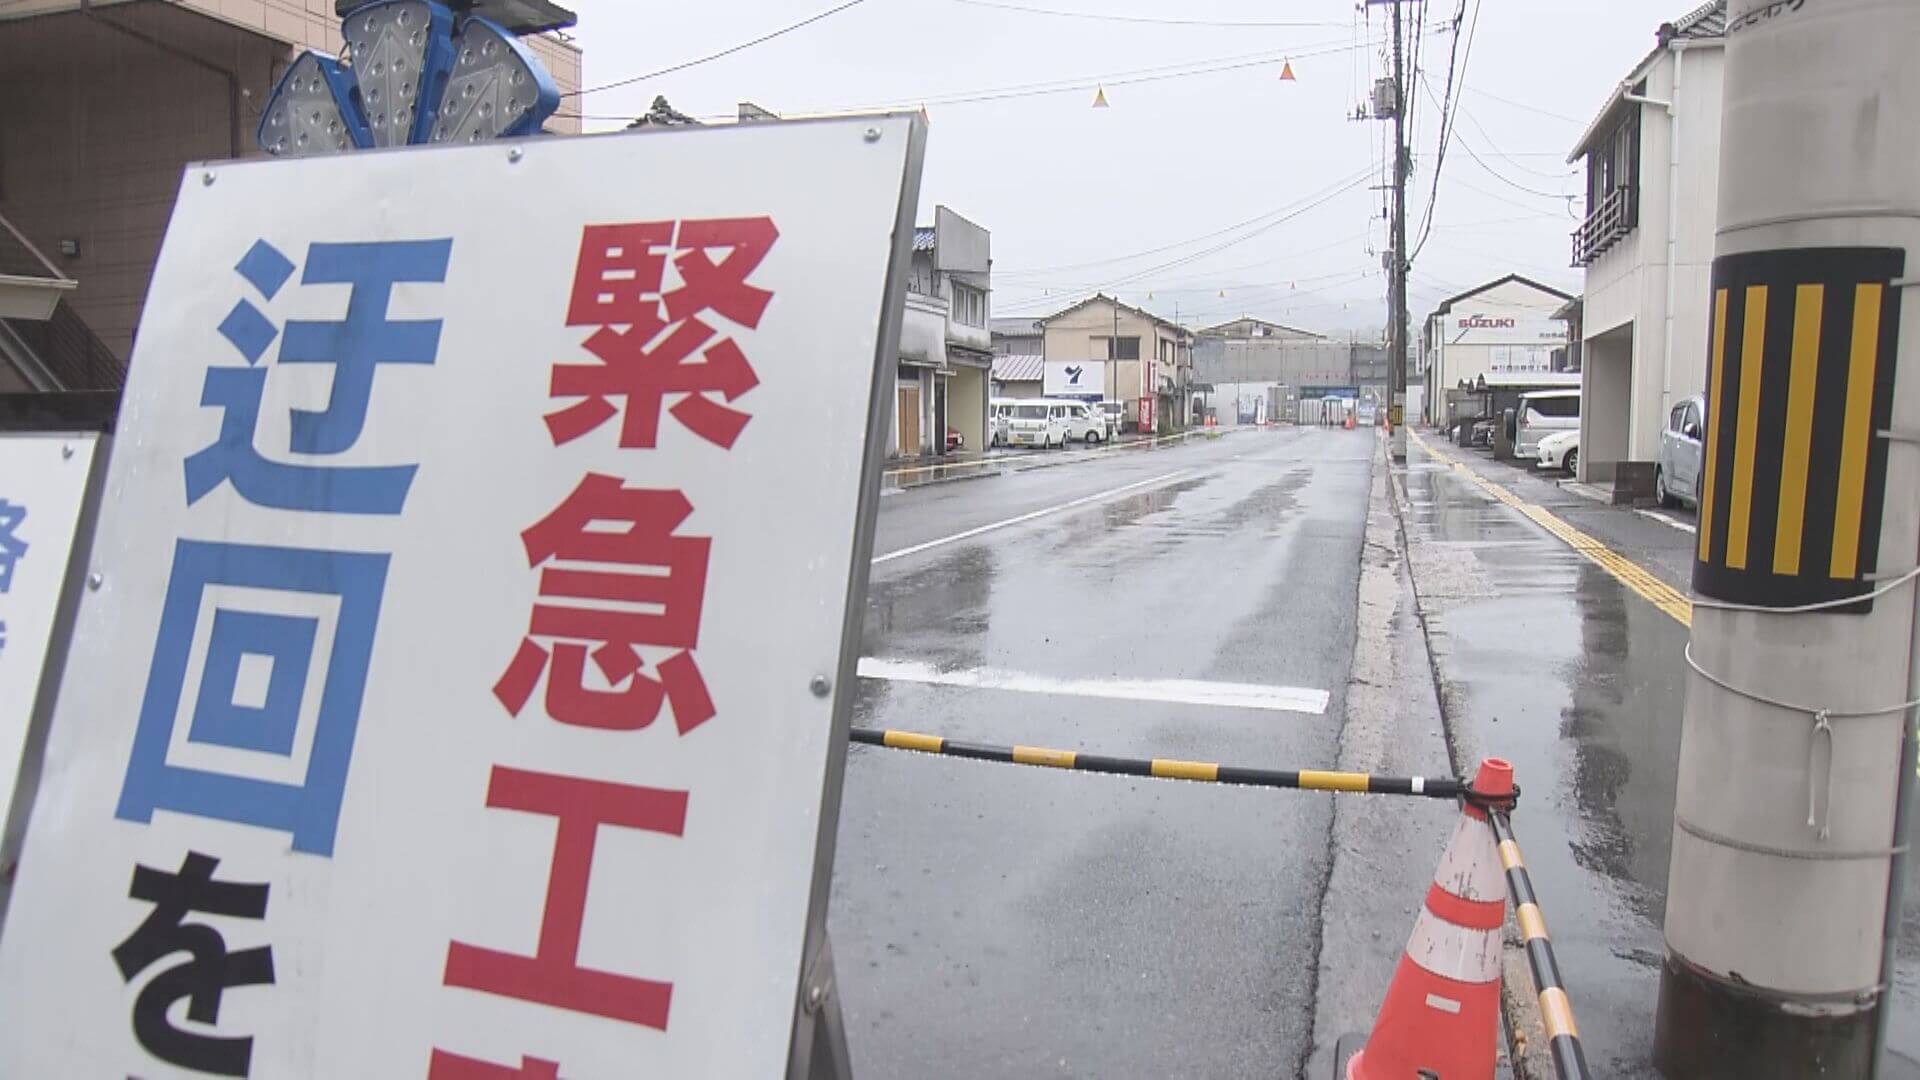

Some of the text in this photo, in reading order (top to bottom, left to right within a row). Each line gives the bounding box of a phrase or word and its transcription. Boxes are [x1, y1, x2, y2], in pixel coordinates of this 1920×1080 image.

[1458, 318, 1515, 329] SUZUKI
[429, 218, 776, 1080] 緊急工
